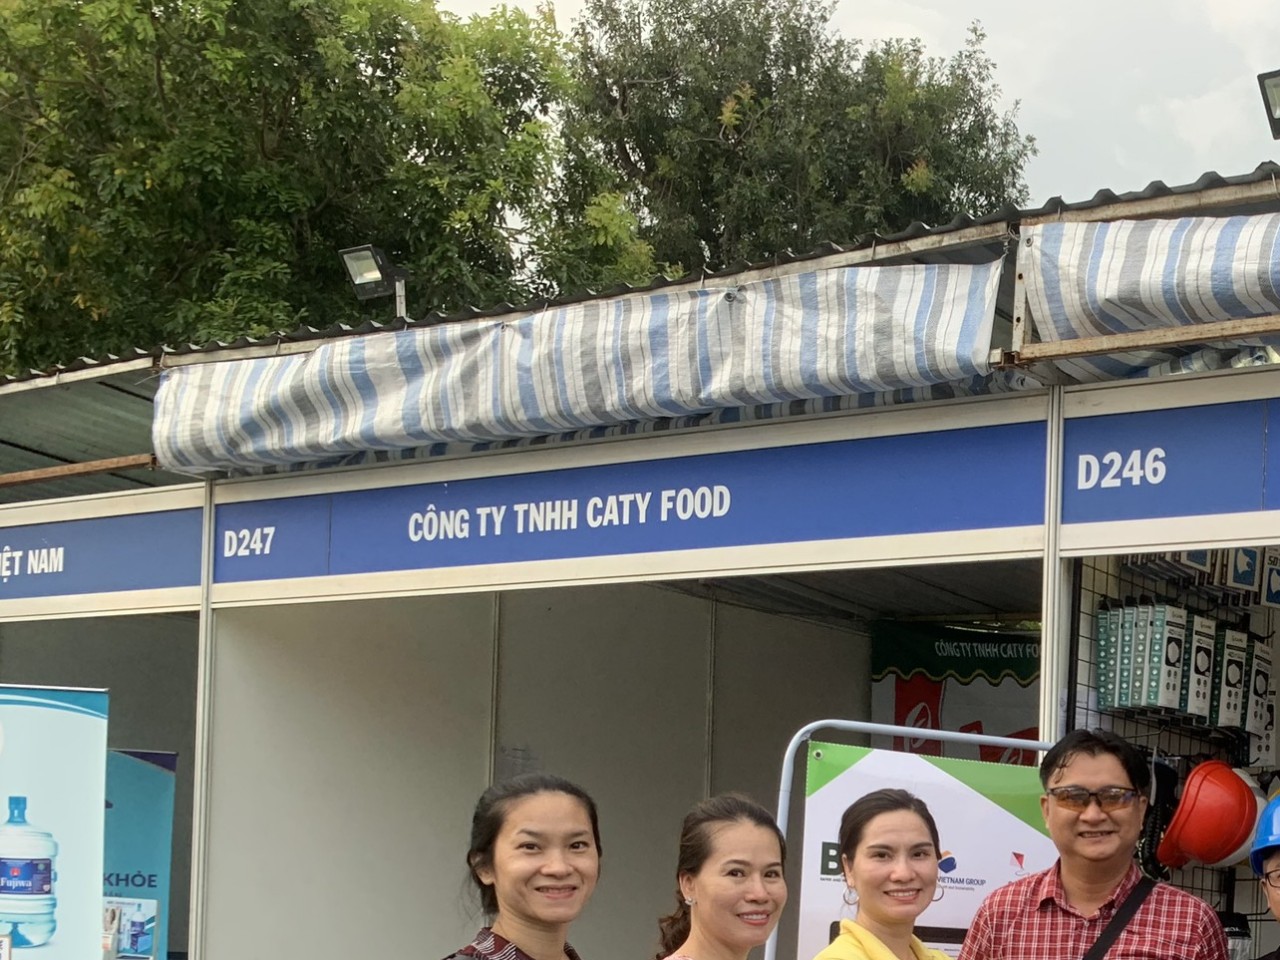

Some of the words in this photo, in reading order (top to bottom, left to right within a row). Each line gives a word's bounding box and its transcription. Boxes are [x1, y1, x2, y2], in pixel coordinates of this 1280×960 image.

[1077, 447, 1167, 490] D246
[408, 504, 470, 542] CÔNG
[476, 505, 507, 537] TY
[514, 499, 578, 533] TNHH
[586, 491, 652, 528] CATY
[660, 485, 731, 522] FOOD
[223, 526, 276, 558] D247
[0, 545, 23, 583] ỆT
[27, 547, 65, 575] NAM
[935, 639, 960, 657] CÔNG
[960, 643, 971, 657] TY
[972, 643, 999, 657] TNHH
[1000, 643, 1024, 658] CATY
[1025, 643, 1041, 658] FO
[103, 870, 158, 888] KHỎE
[965, 878, 986, 886] GROUP
